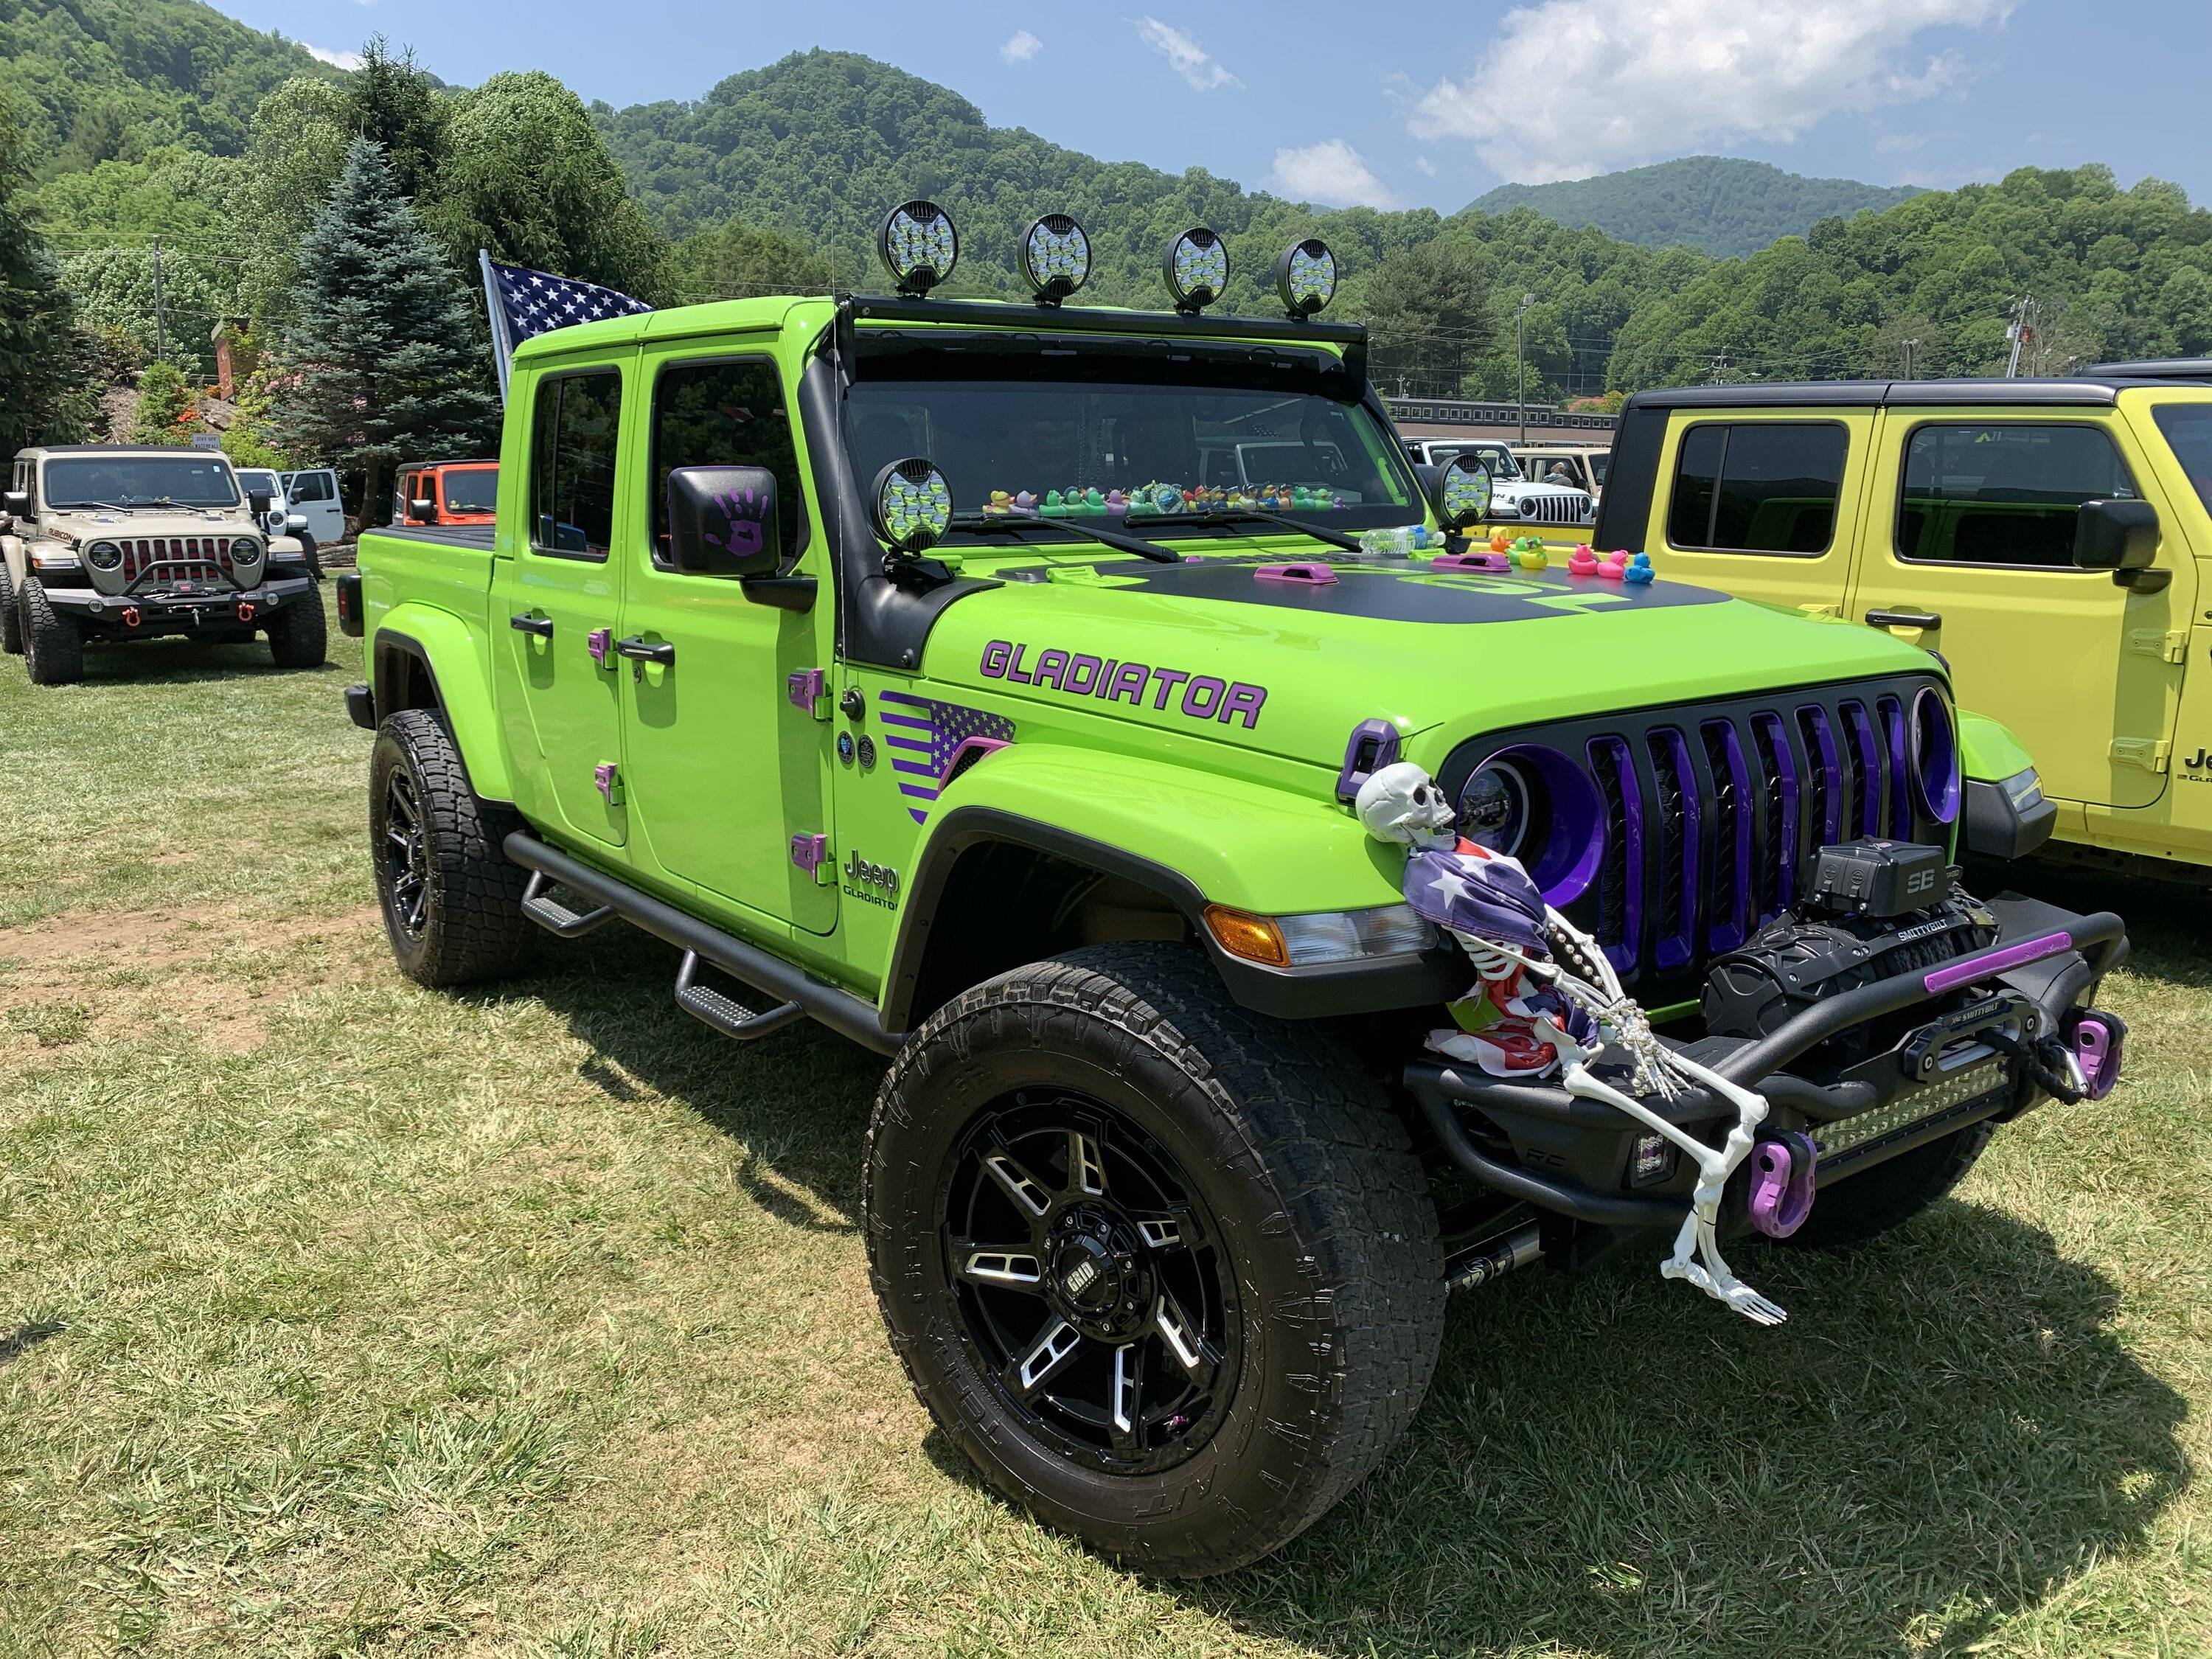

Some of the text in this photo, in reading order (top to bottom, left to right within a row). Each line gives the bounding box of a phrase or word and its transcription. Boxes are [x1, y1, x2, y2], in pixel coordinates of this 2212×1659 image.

[48, 527, 74, 542] RUBICON
[980, 639, 1267, 730] GLADIATOR
[844, 849, 898, 897] Jeep
[1898, 919, 1947, 942] SMITTYBILT
[1067, 1262, 1094, 1292] GRID
